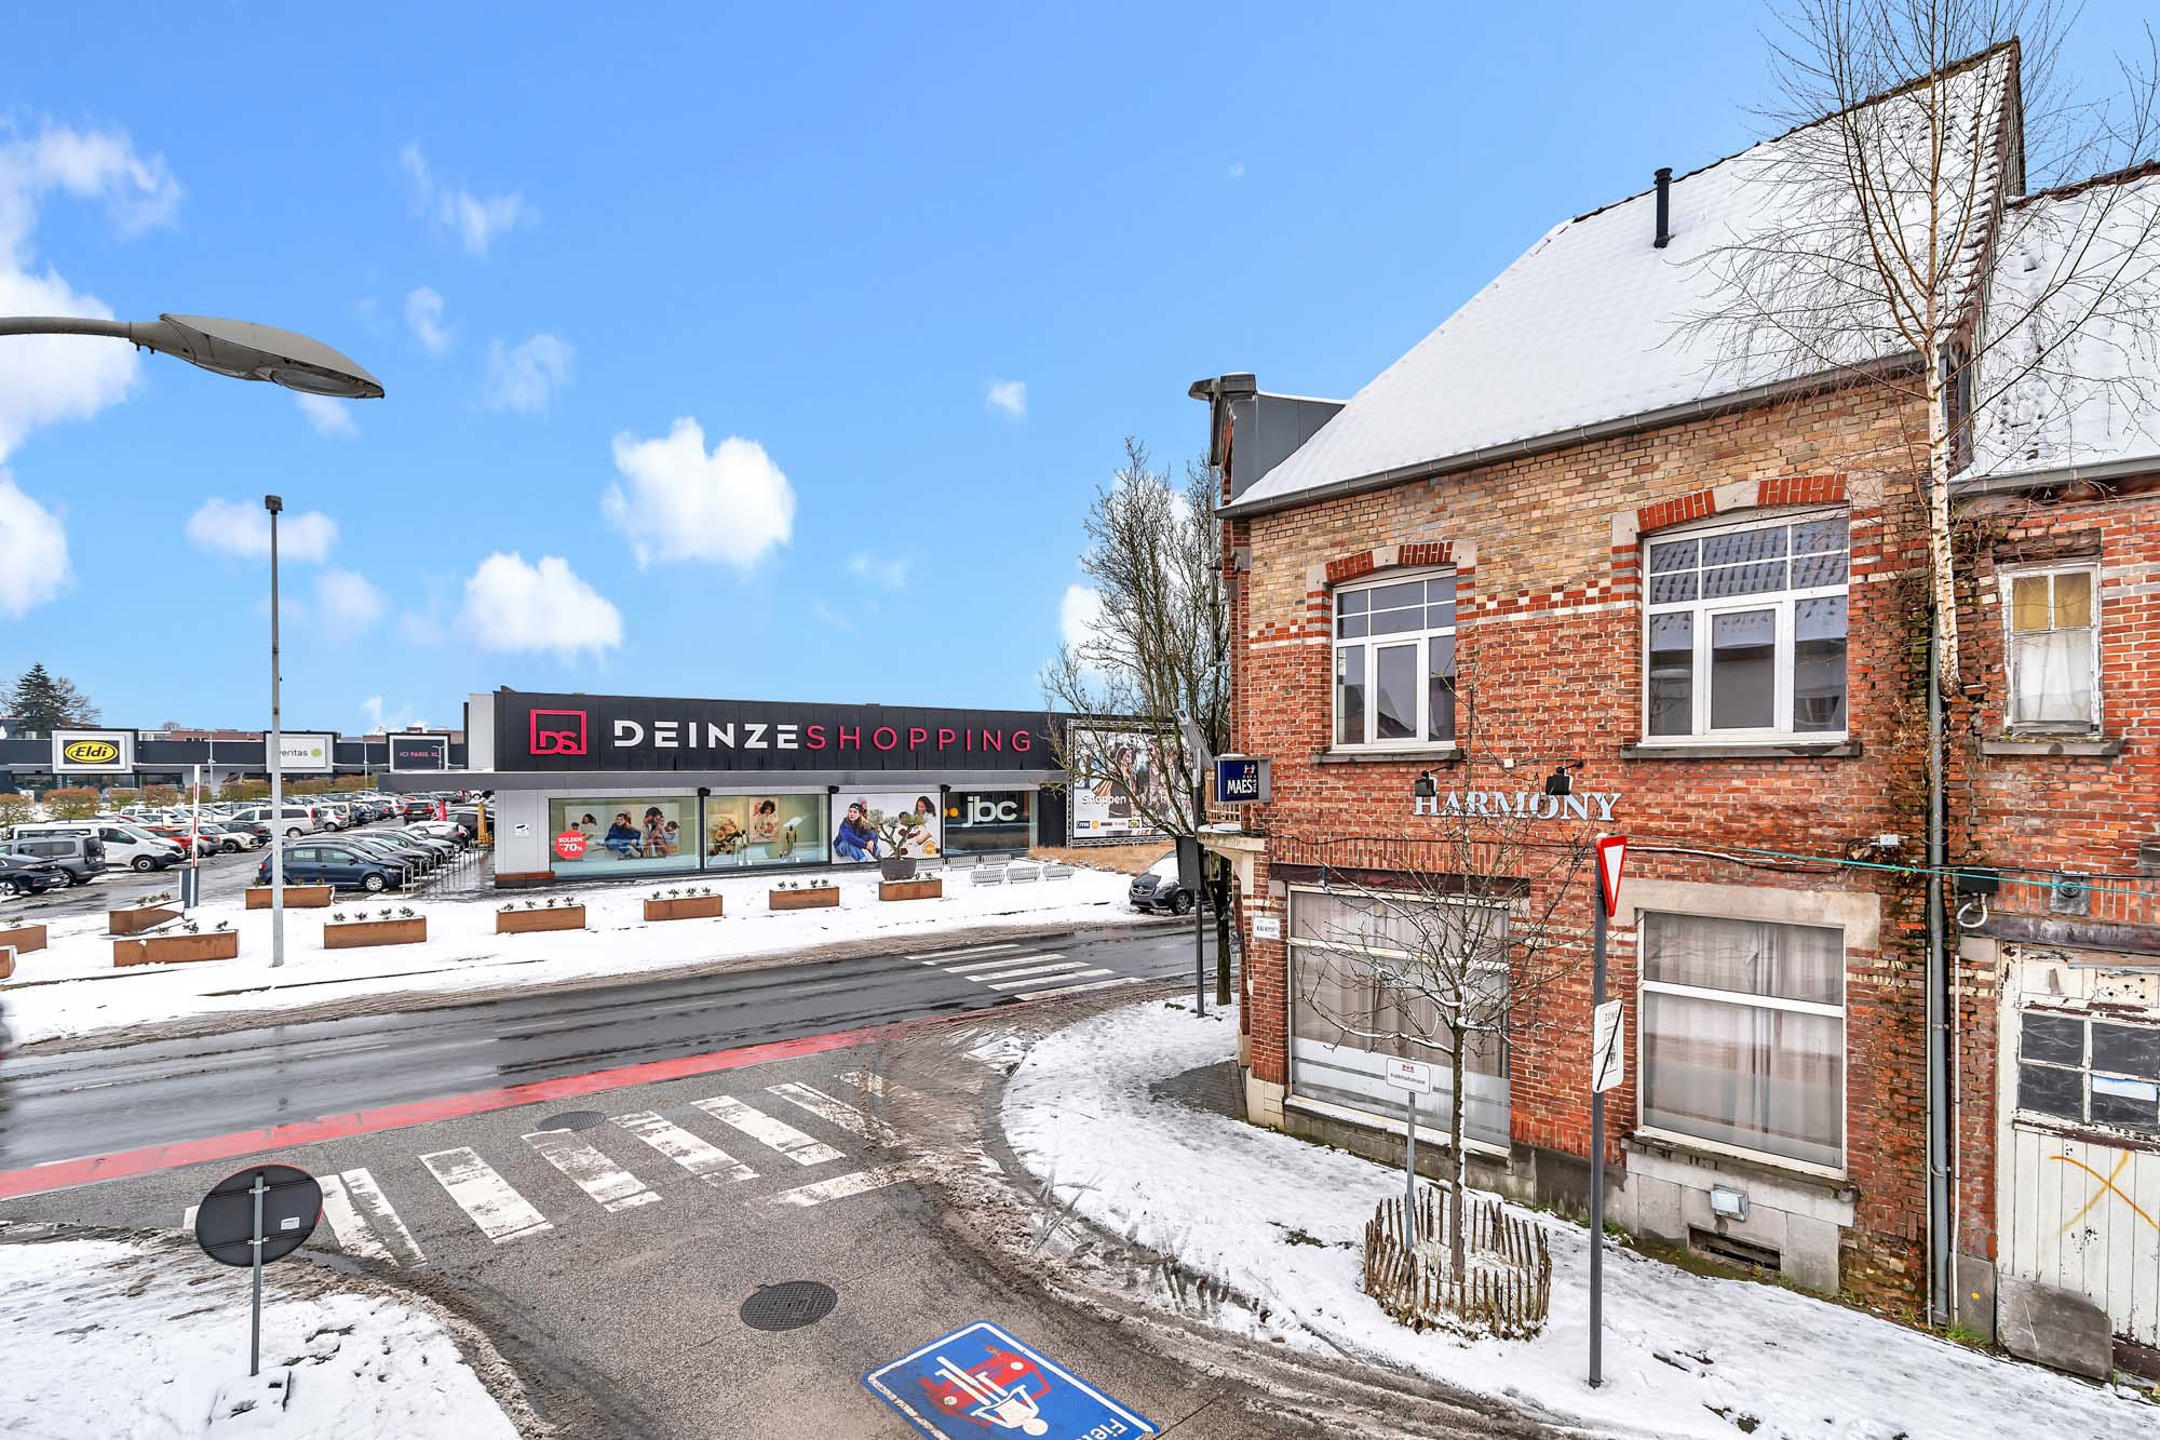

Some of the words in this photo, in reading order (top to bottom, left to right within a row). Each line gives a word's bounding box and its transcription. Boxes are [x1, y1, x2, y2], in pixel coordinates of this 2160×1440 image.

[613, 719, 800, 750] DEINZE
[805, 725, 1031, 752] SHOPPING
[75, 745, 107, 757] Eldi
[1227, 779, 1253, 794] MAES
[962, 795, 1018, 828] jbc
[1082, 795, 1127, 807] Shoppen
[1413, 791, 1622, 821] HARMONY
